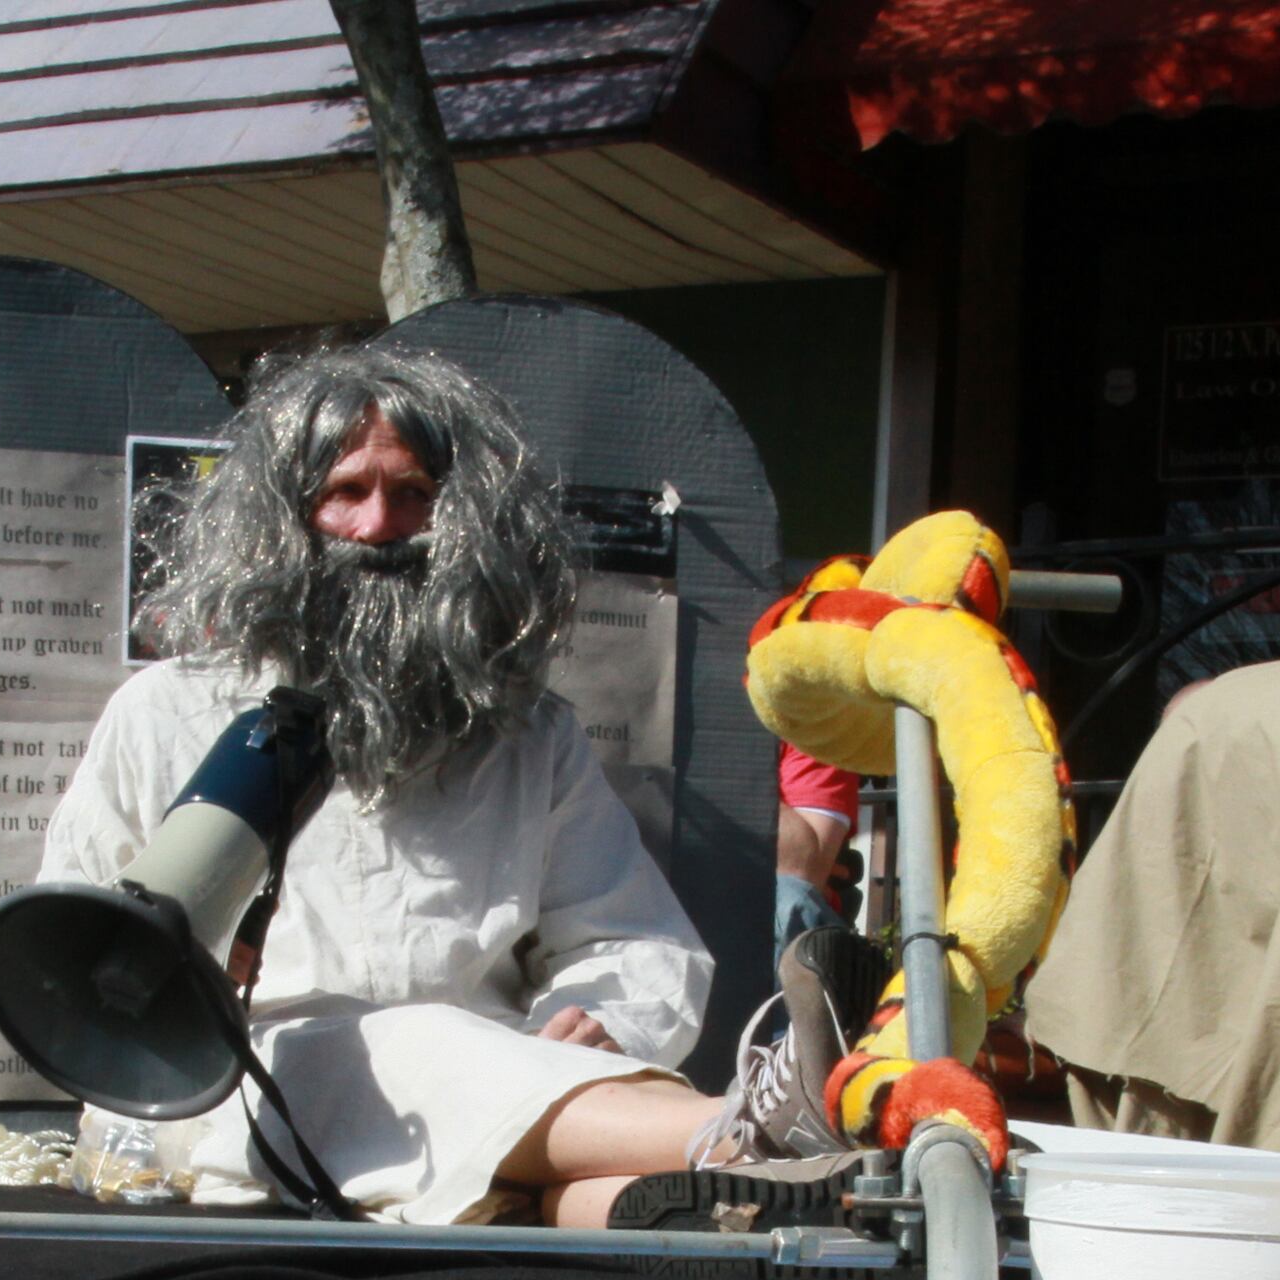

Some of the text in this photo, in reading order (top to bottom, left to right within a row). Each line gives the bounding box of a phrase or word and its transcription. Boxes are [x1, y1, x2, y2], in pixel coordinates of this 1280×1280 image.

[1175, 382, 1239, 400] Law
[21, 488, 67, 511] have
[75, 494, 99, 511] no
[3, 525, 65, 547] before
[73, 533, 107, 549] me.
[11, 597, 44, 616] not
[51, 600, 105, 619] make
[34, 637, 104, 657] graven
[13, 739, 45, 757] not
[58, 740, 90, 758] tak
[17, 774, 46, 796] the
[1, 812, 20, 831] in
